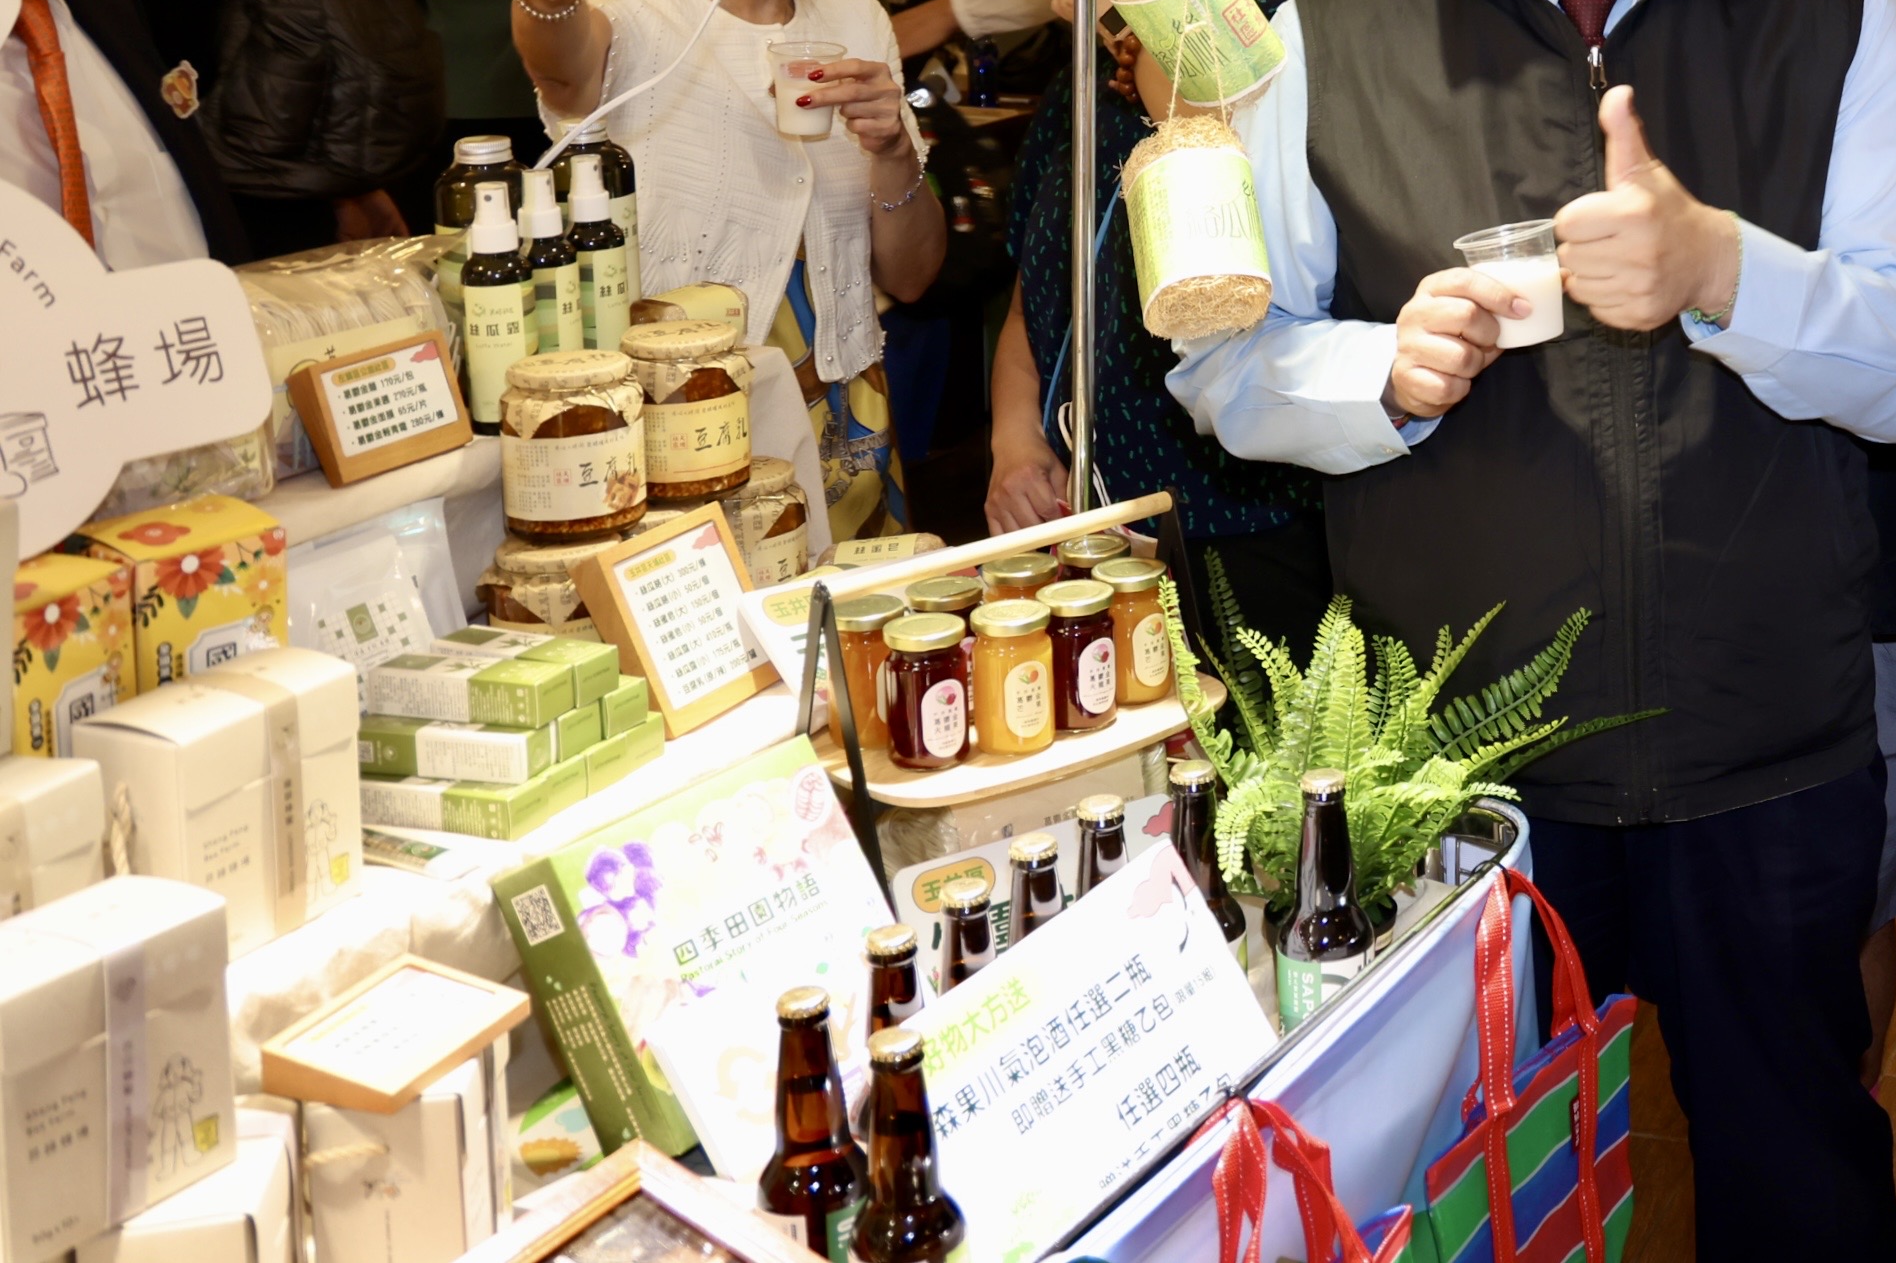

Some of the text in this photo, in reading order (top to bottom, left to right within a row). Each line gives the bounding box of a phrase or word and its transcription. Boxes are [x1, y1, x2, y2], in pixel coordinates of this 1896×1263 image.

[0, 240, 57, 311] Farm
[64, 316, 225, 411] 蜂場
[578, 452, 638, 488] 豆腐乳
[694, 416, 748, 452] 豆腐乳
[673, 873, 820, 966] 四季田園物語
[923, 976, 1032, 1078] 好物大方送
[932, 953, 1153, 1139] 森果川氣泡酒任選二瓶
[1116, 1044, 1202, 1131] 任選四瓶
